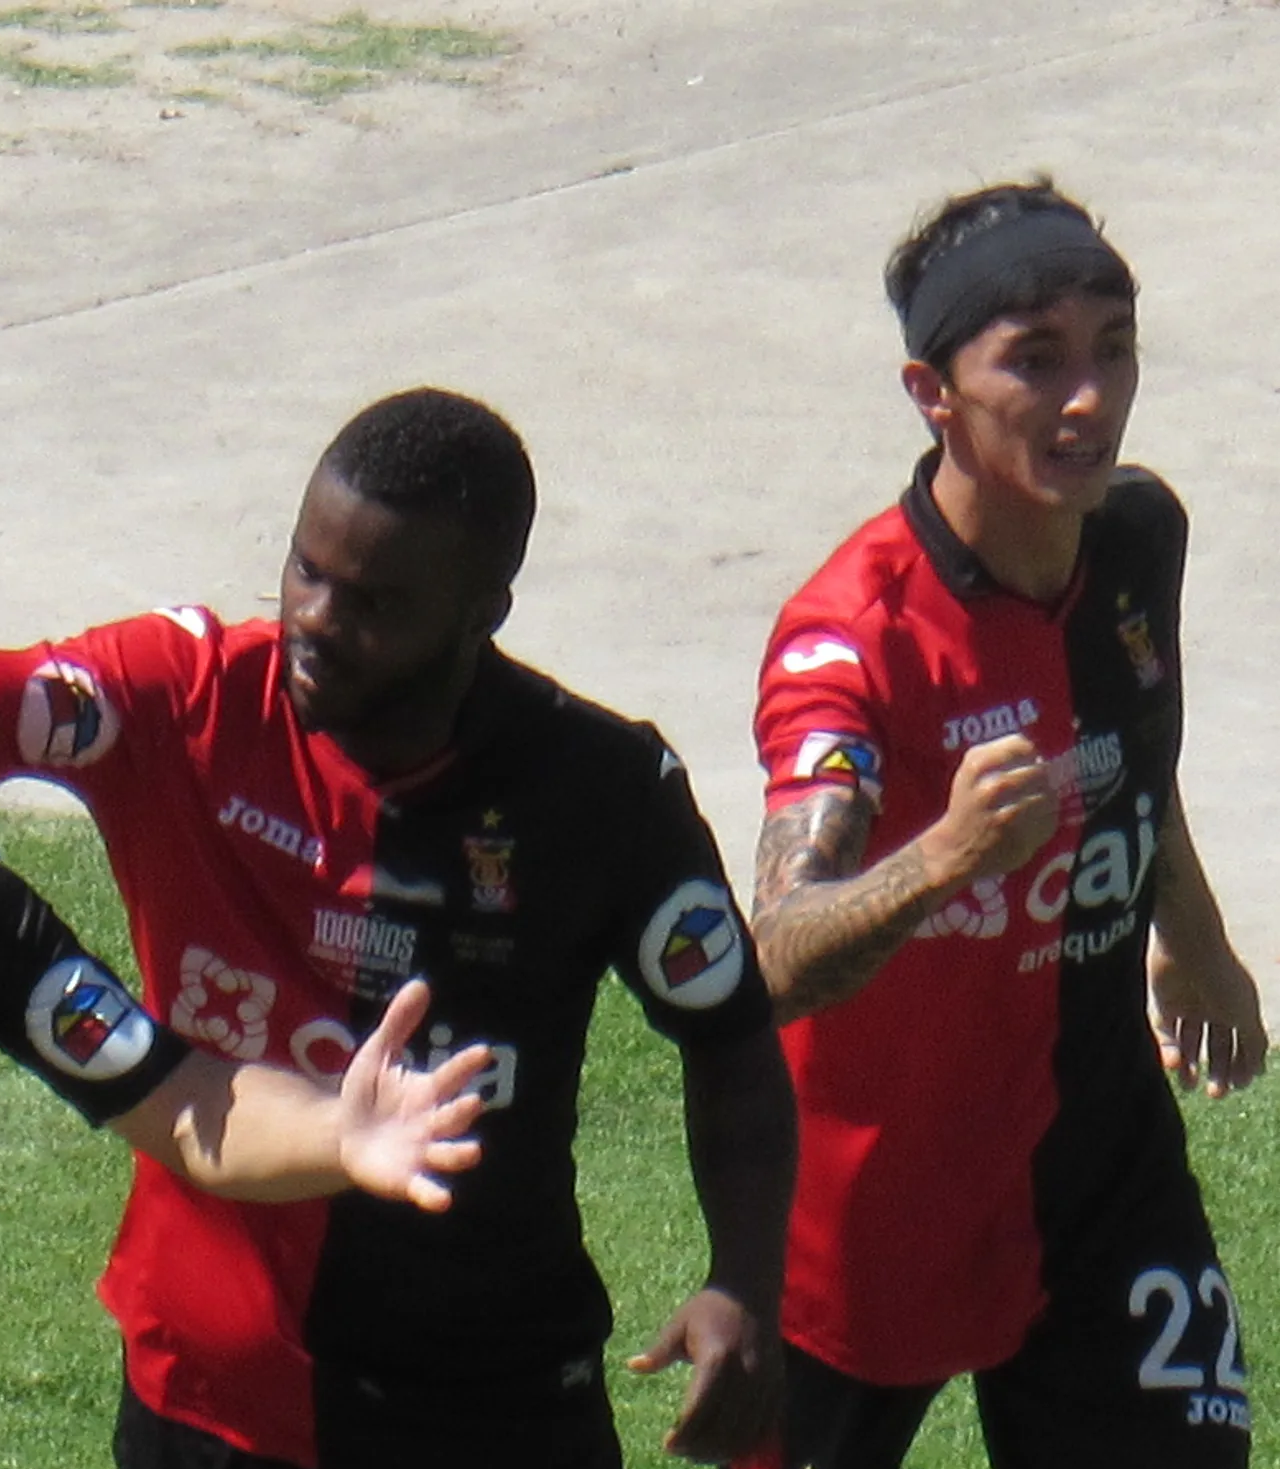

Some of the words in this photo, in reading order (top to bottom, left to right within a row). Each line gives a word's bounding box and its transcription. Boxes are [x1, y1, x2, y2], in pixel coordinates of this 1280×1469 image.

[942, 699, 1041, 749] Joma
[218, 797, 326, 866] Joma
[1026, 793, 1157, 923] caj
[1129, 1268, 1247, 1393] 22
[1187, 1395, 1251, 1431] Jom
